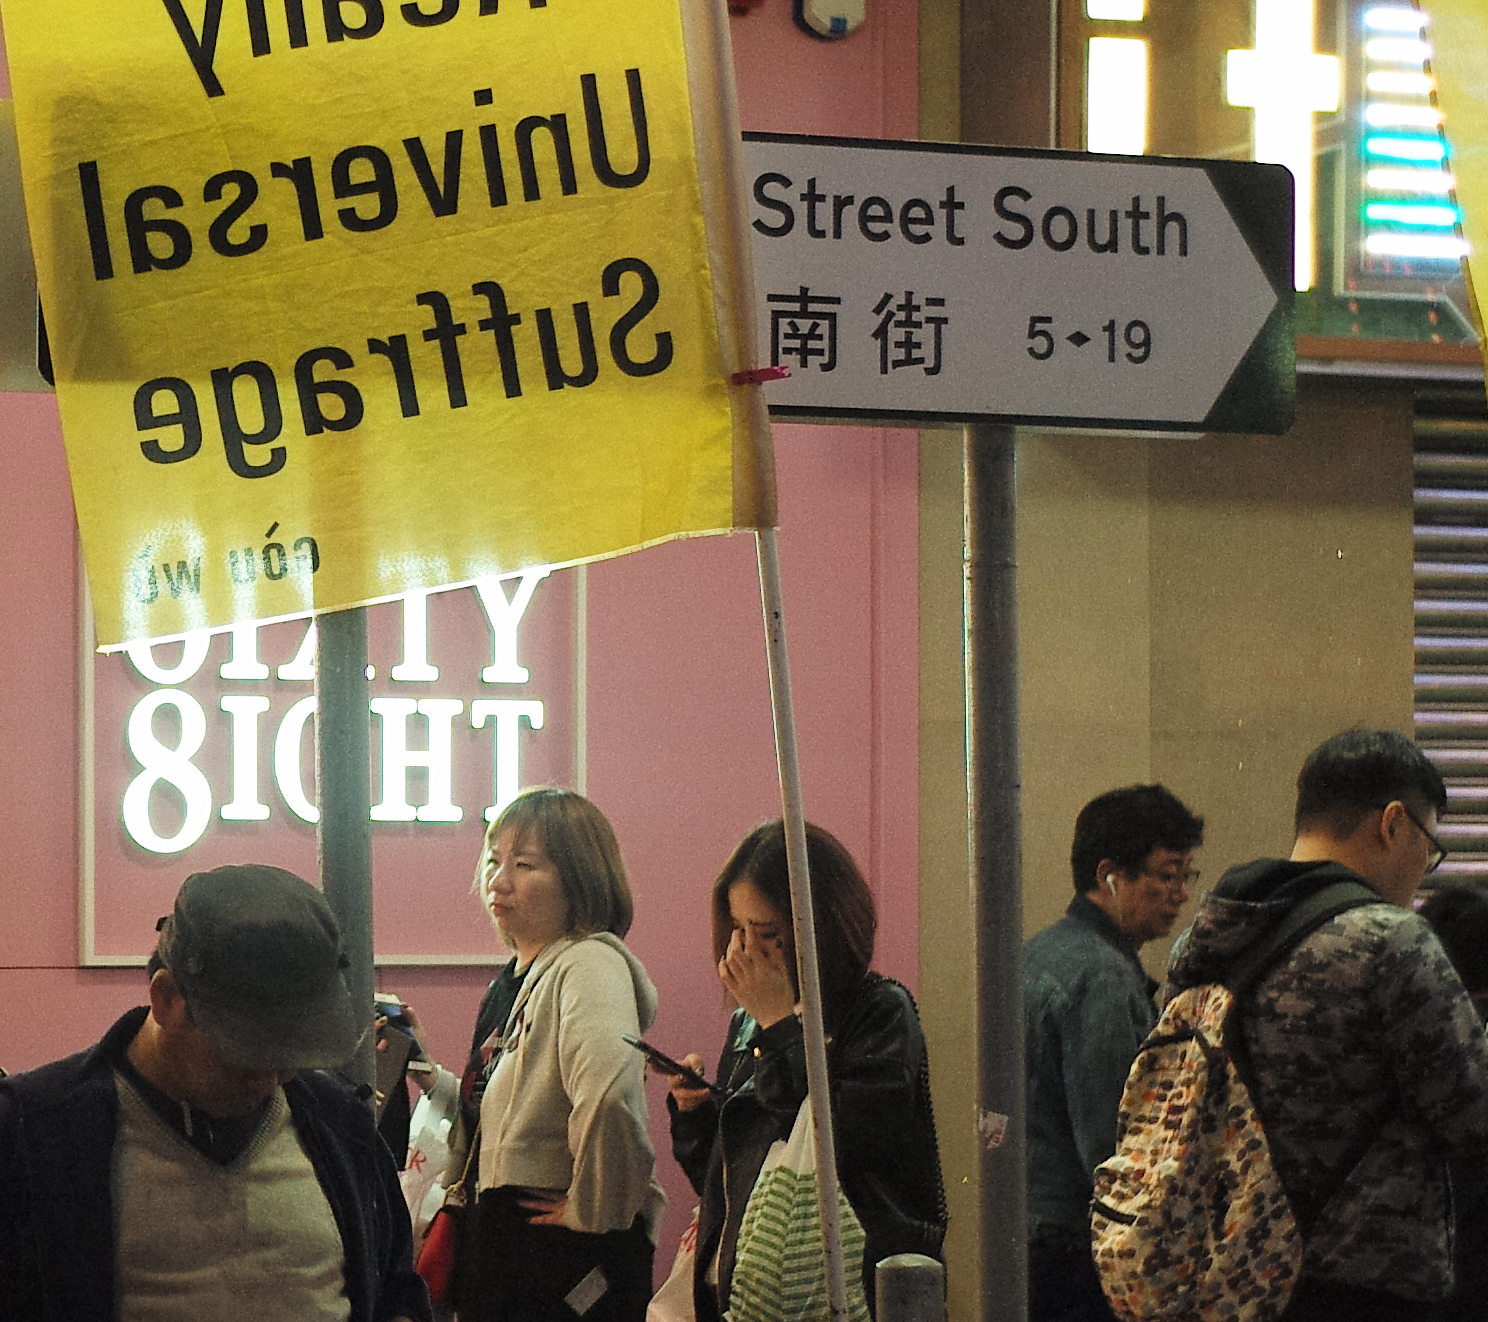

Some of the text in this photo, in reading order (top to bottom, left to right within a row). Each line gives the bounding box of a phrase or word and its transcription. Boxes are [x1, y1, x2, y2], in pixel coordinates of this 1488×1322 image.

[751, 171, 1189, 257] Street South
[766, 285, 948, 376] 南街
